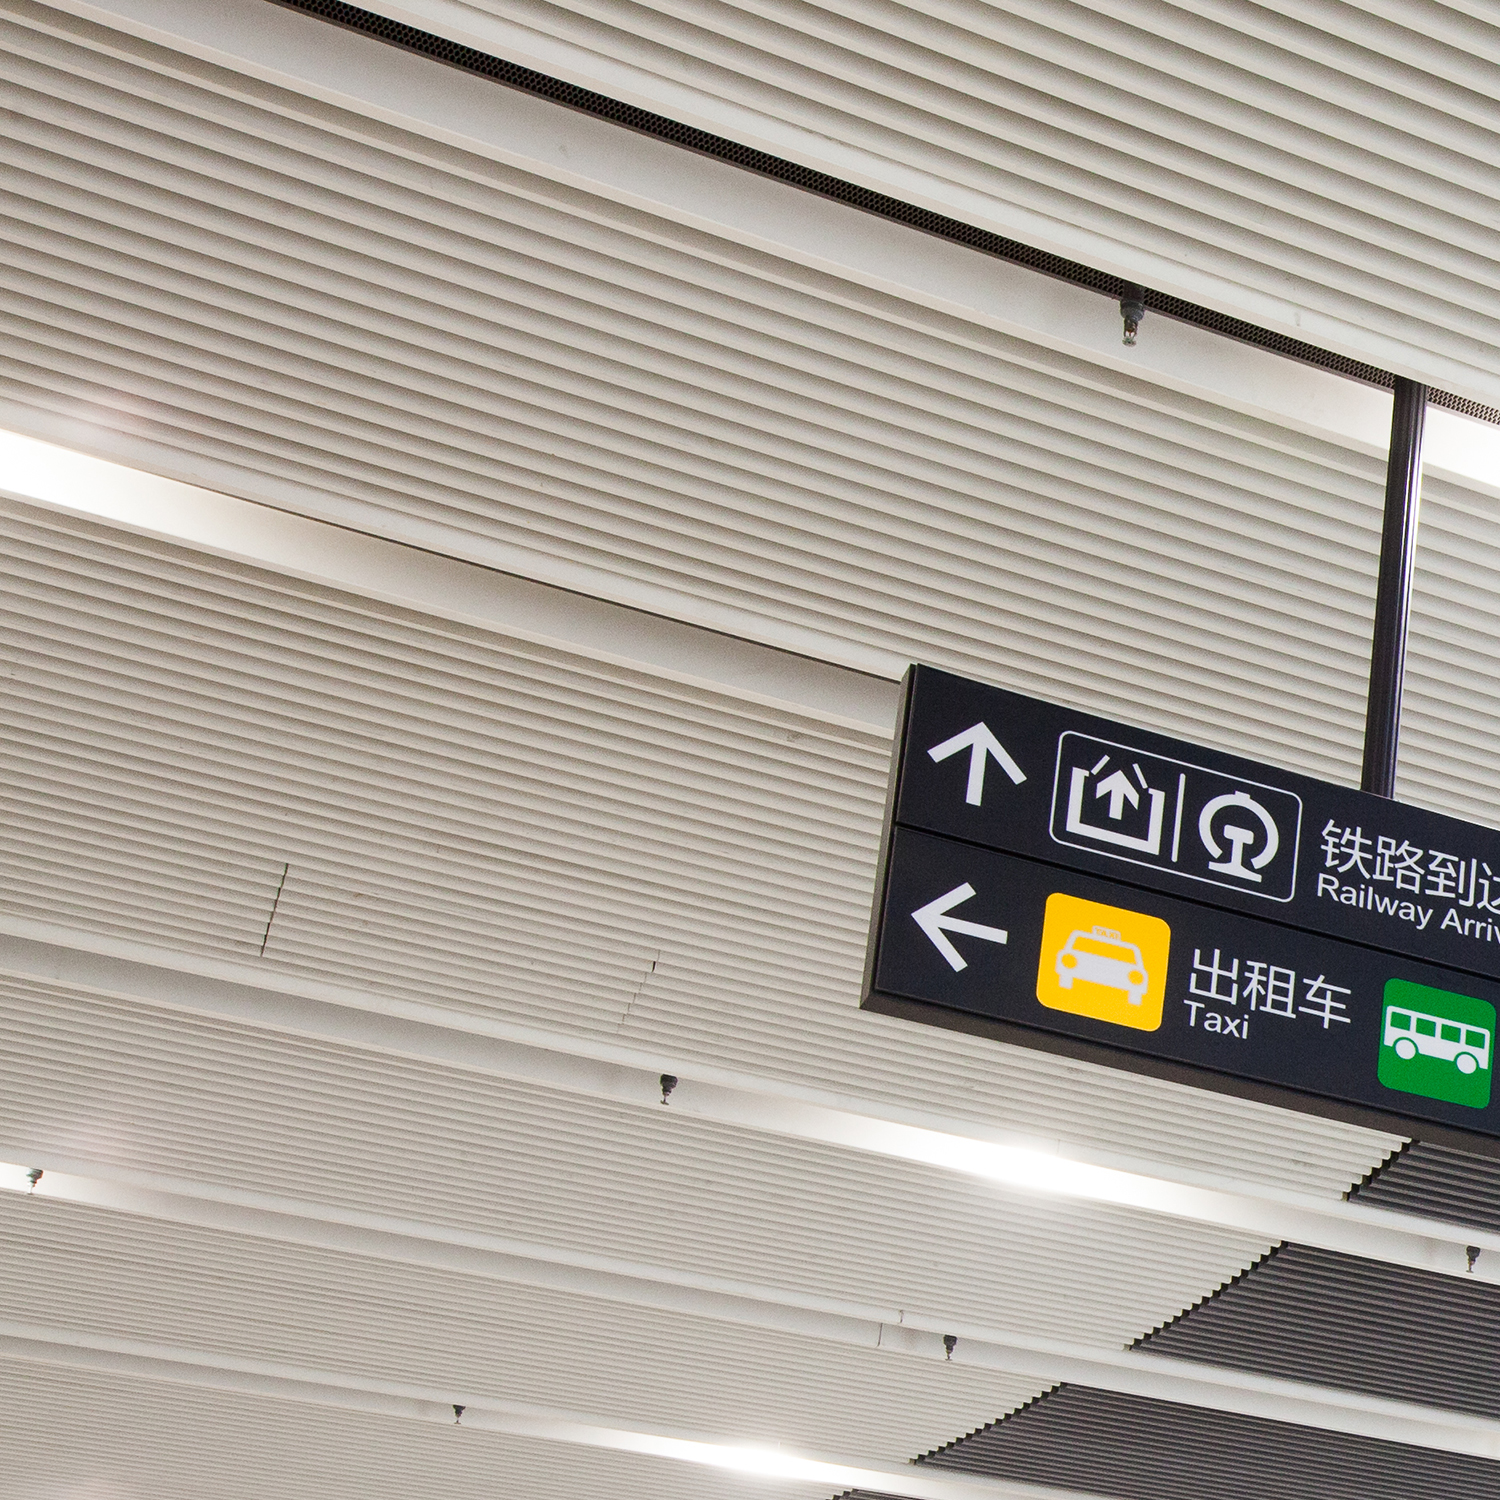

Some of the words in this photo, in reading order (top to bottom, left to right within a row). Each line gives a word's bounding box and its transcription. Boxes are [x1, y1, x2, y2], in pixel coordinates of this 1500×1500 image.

[1316, 872, 1434, 931] Railway
[1188, 948, 1352, 1030] 出租车
[1183, 999, 1249, 1040] Taxi
